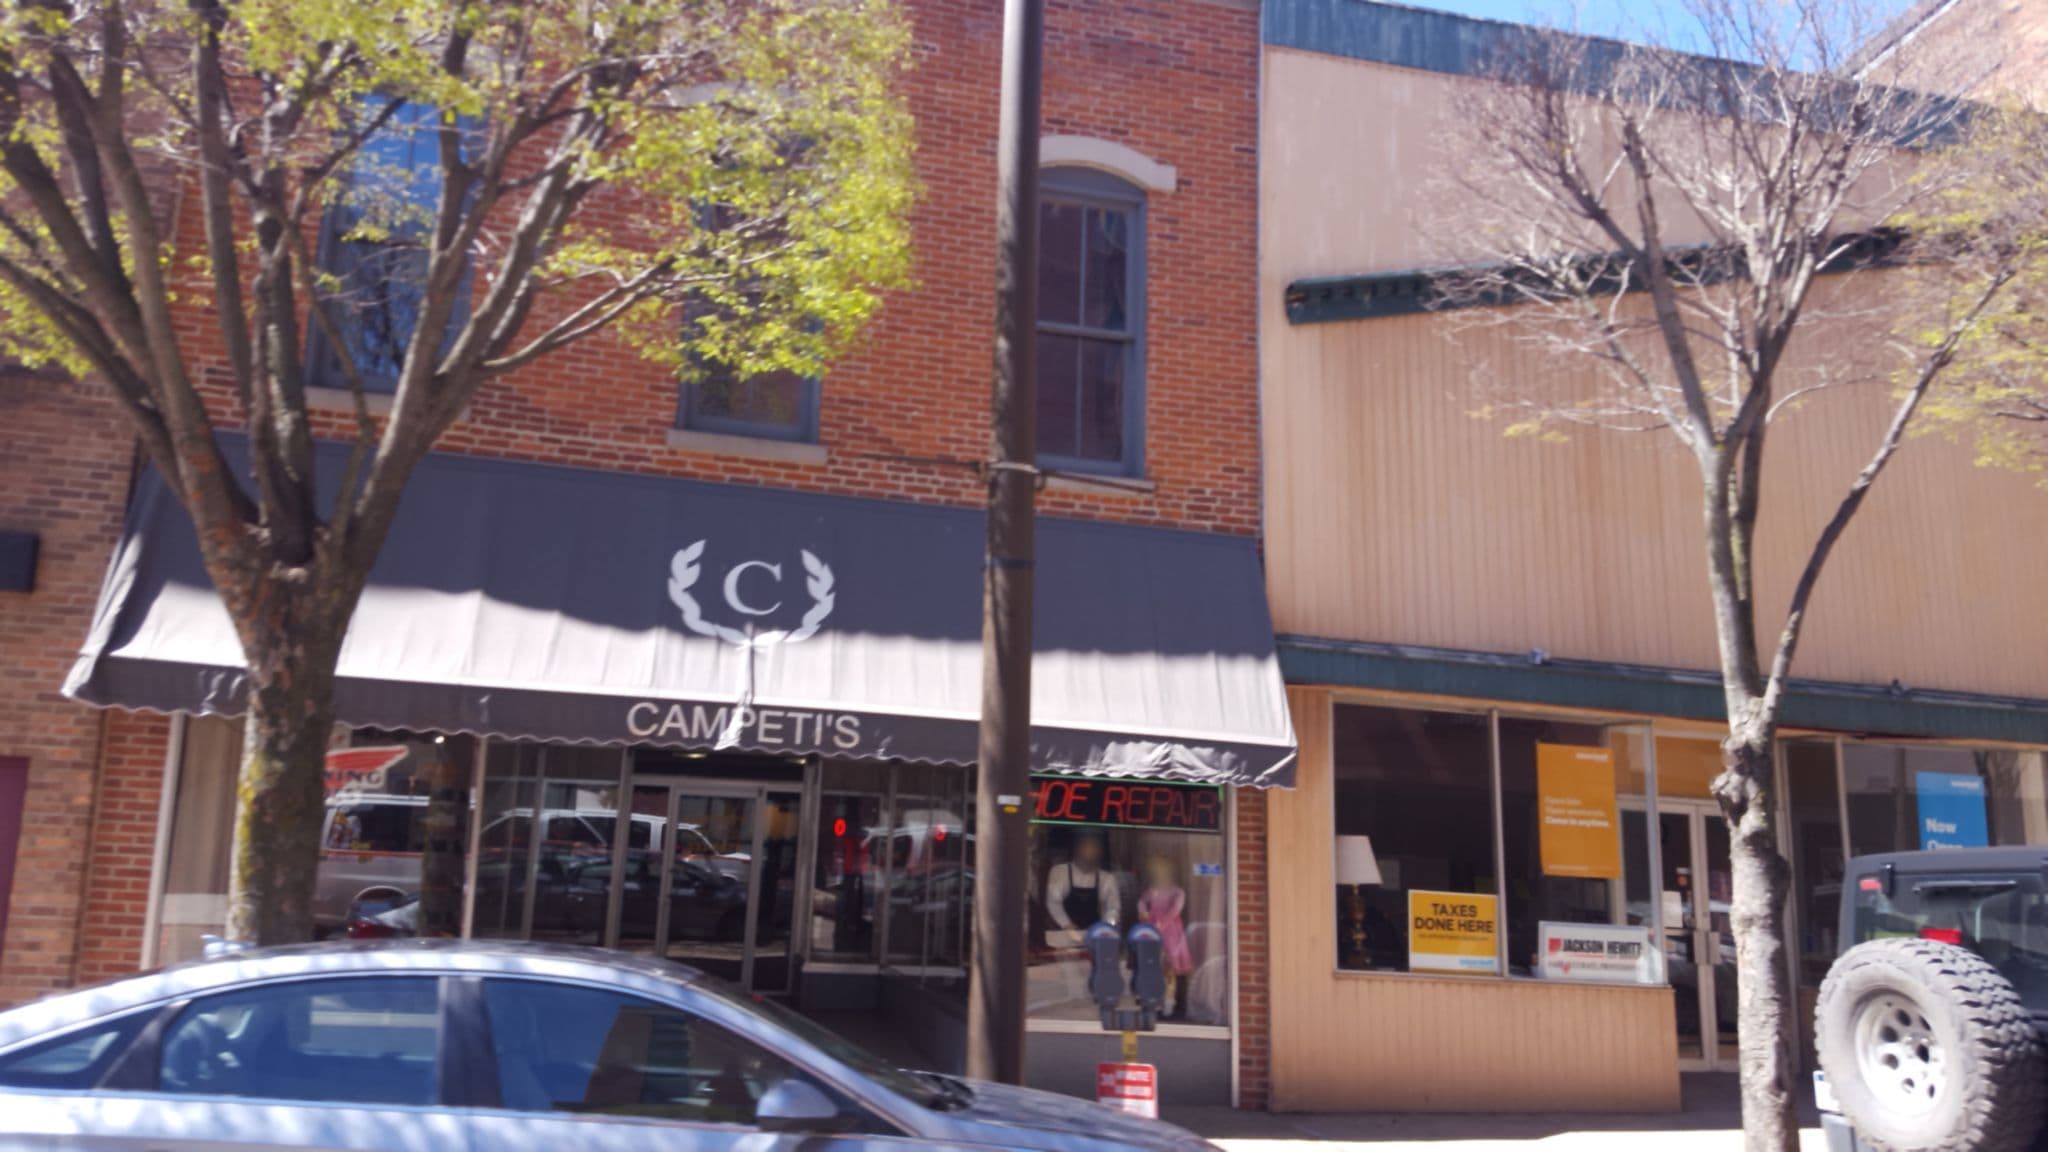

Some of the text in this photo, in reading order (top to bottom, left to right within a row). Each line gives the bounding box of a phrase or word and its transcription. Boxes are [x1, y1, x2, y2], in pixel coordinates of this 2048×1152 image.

[723, 560, 782, 616] C
[626, 702, 861, 749] CAMPETI'S
[1101, 786, 1217, 825] REPAIR
[1432, 904, 1478, 917] TAXES
[1414, 917, 1494, 933] DONE HERE
[1563, 938, 1604, 952] JACKSON
